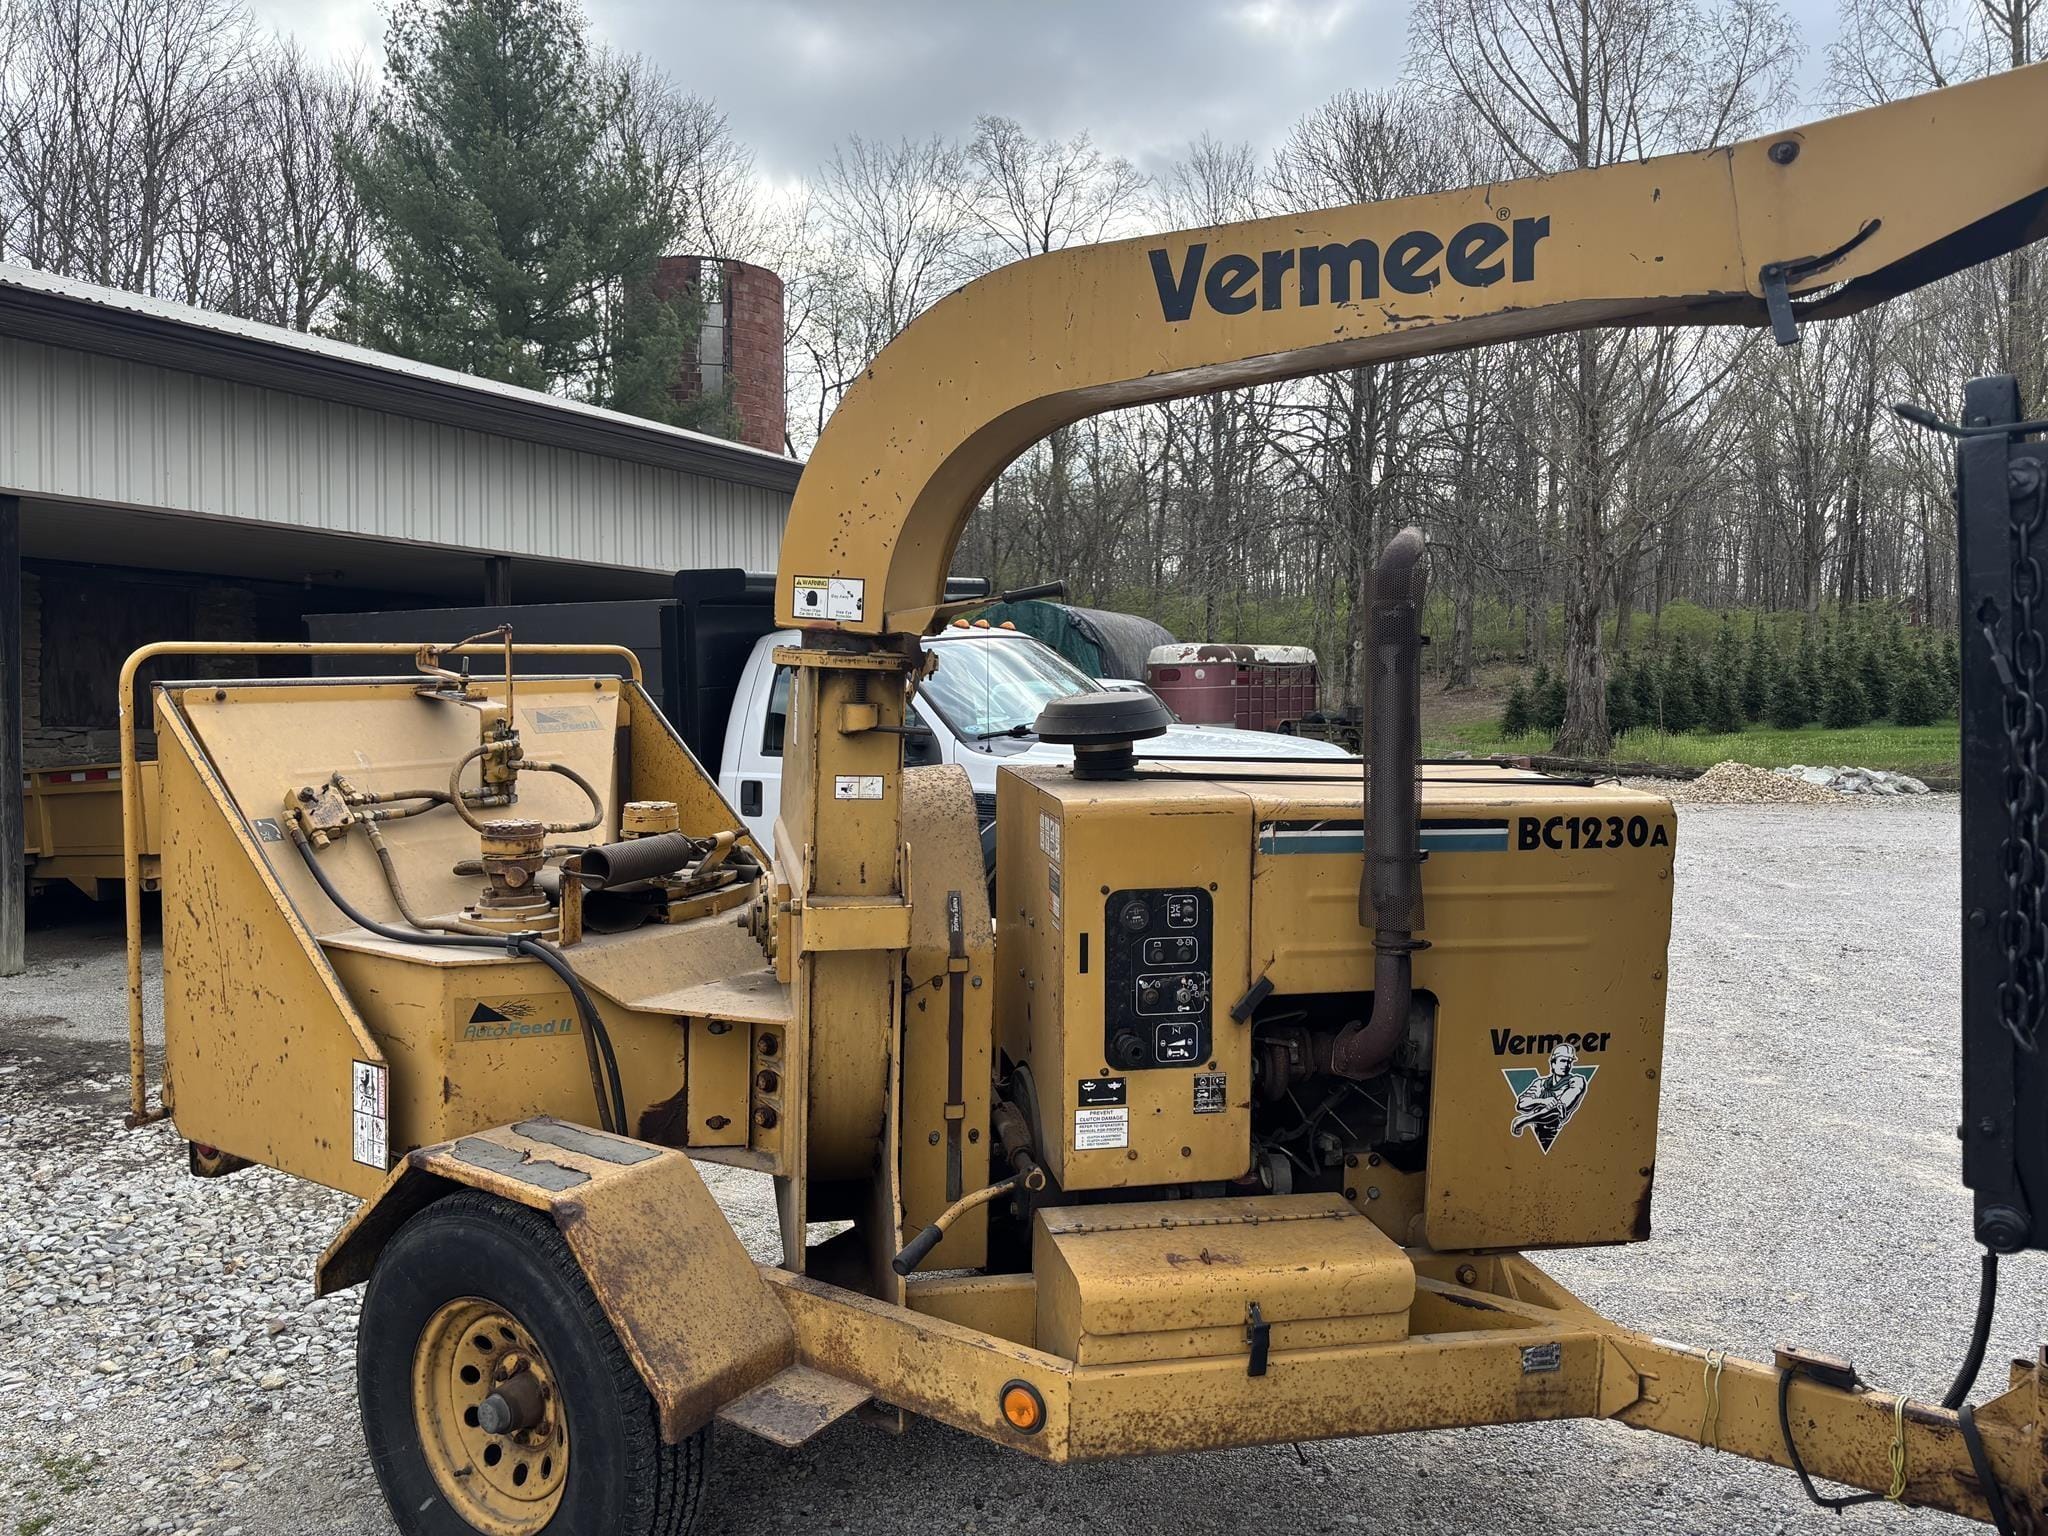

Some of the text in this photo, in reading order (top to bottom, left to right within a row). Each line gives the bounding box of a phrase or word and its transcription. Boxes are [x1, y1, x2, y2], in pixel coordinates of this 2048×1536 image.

[1148, 214, 1550, 322] Vermeer
[802, 579, 828, 587] WARNING
[1490, 1028, 1611, 1056] Vermeer
